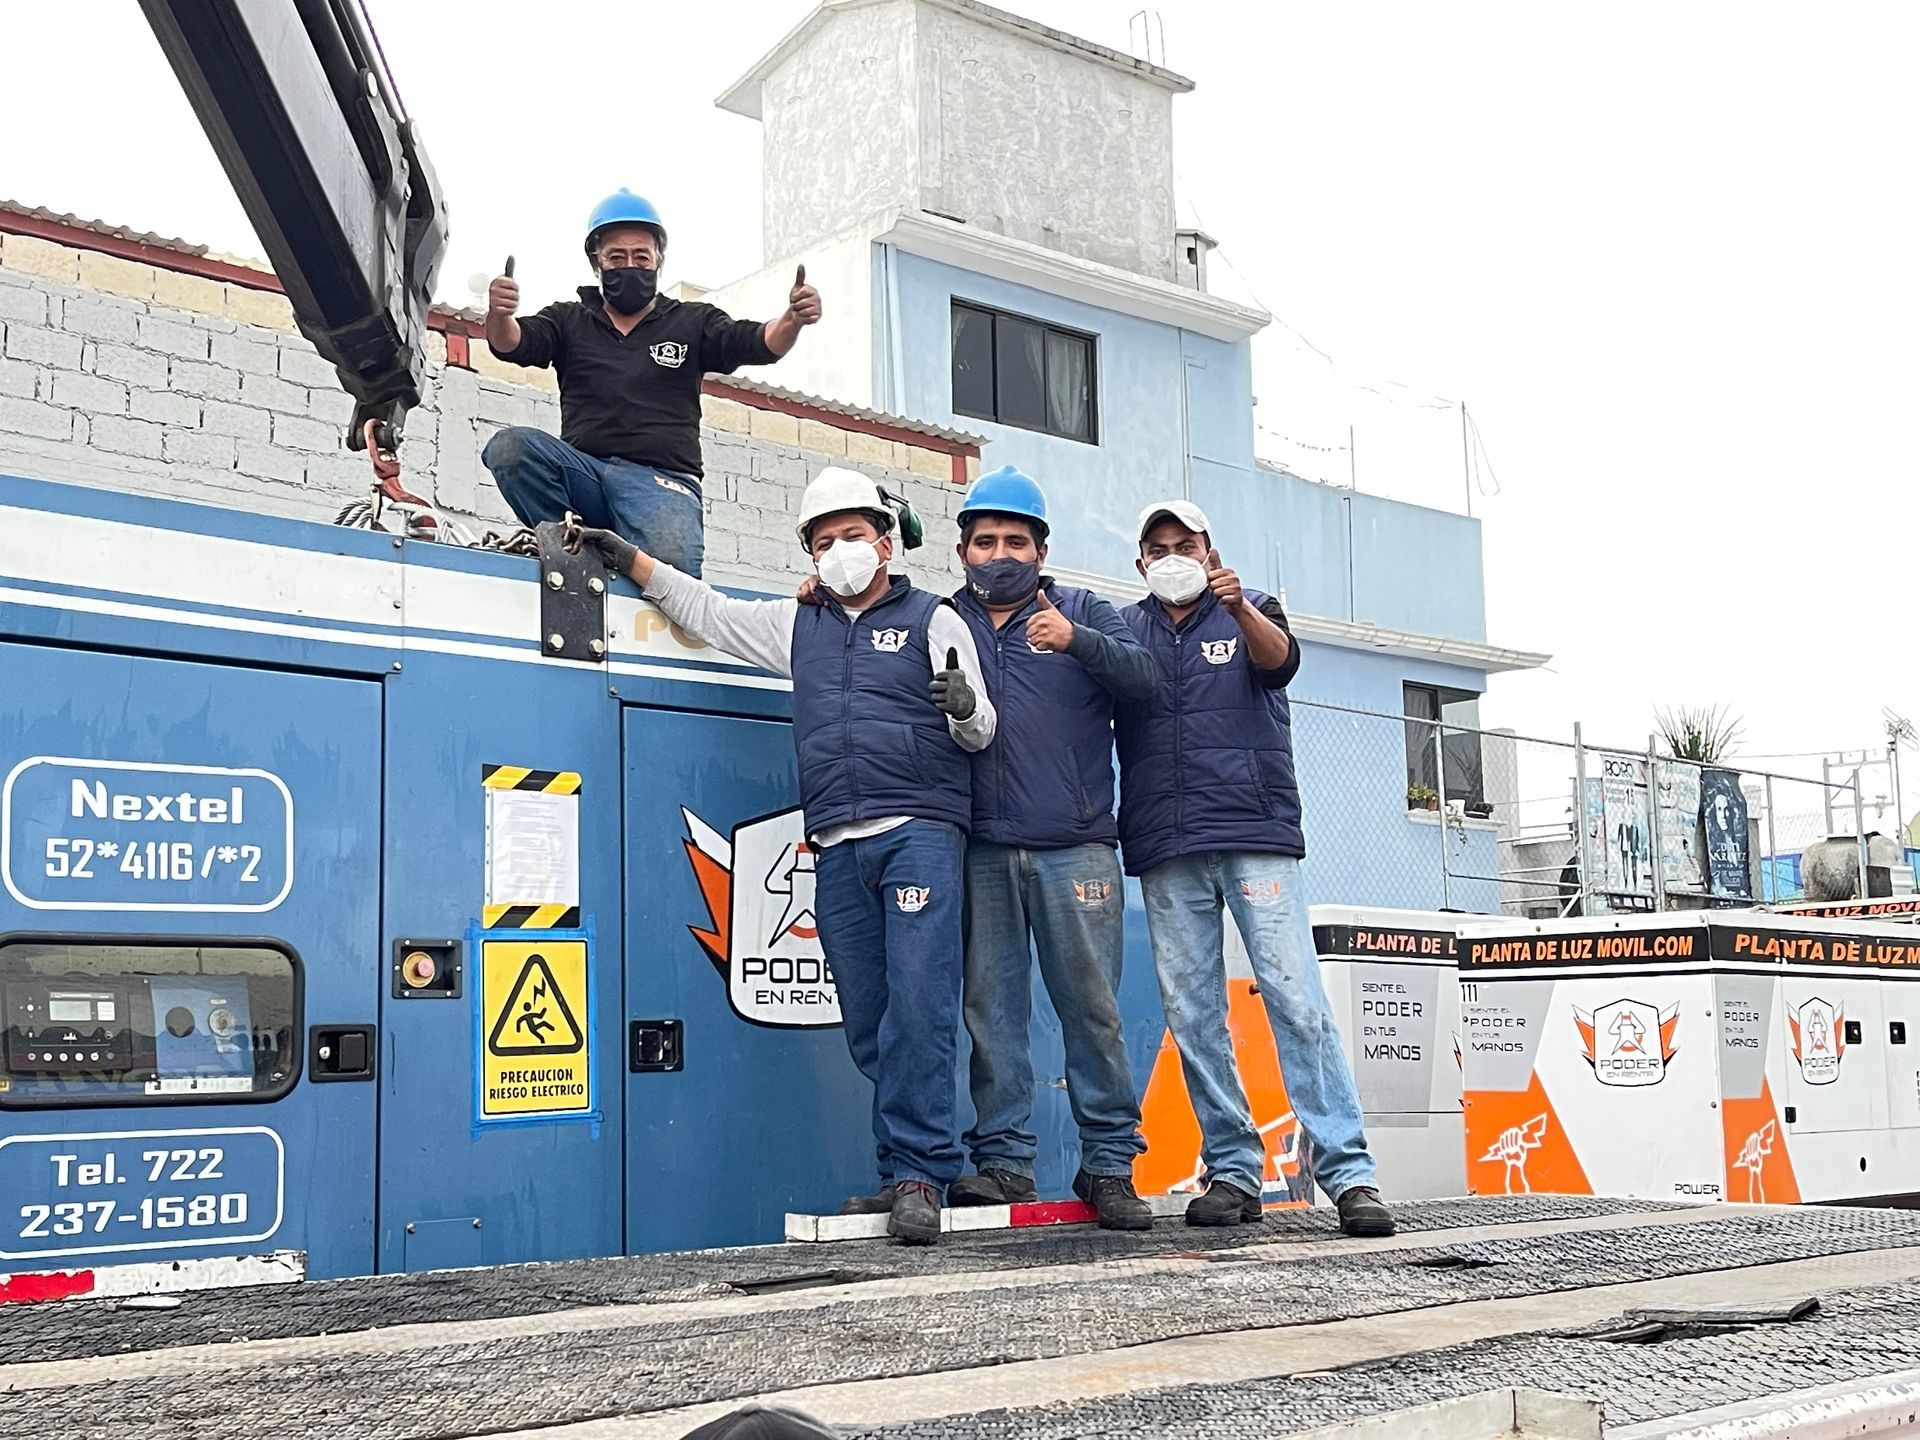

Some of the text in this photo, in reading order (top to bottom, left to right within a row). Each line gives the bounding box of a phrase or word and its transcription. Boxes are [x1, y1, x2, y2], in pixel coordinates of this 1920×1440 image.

[71, 778, 243, 824] Nextel
[1824, 906, 1862, 918] LUZ
[1356, 932, 1417, 953] PLANTA
[1421, 936, 1441, 954] DE
[1471, 935, 1693, 963] PLANTA DE LUZ MOVIL.COM
[1735, 934, 1824, 960] PLANTA
[1832, 941, 1860, 961] DE
[1866, 945, 1905, 964] LUZ
[1362, 983, 1407, 993] SIENTE EL
[1461, 984, 1478, 1002] 111
[756, 990, 838, 1005] EN REN
[1363, 1000, 1422, 1017] PODER
[1724, 1011, 1760, 1022] PODER
[1470, 1018, 1527, 1027] PODER
[1364, 1026, 1397, 1036] EN TUS
[1471, 1042, 1524, 1052] MANOS
[1725, 1038, 1759, 1048] MANOS
[1364, 1044, 1421, 1061] MANOS
[1600, 1058, 1660, 1070] PODER
[500, 1068, 573, 1084] PRECAUCION
[489, 1084, 584, 1100] RIESGO ELECTRICO
[50, 1148, 224, 1187] Tel. 722
[1674, 1183, 1720, 1195] POWER
[19, 1193, 248, 1238] 237-1580
